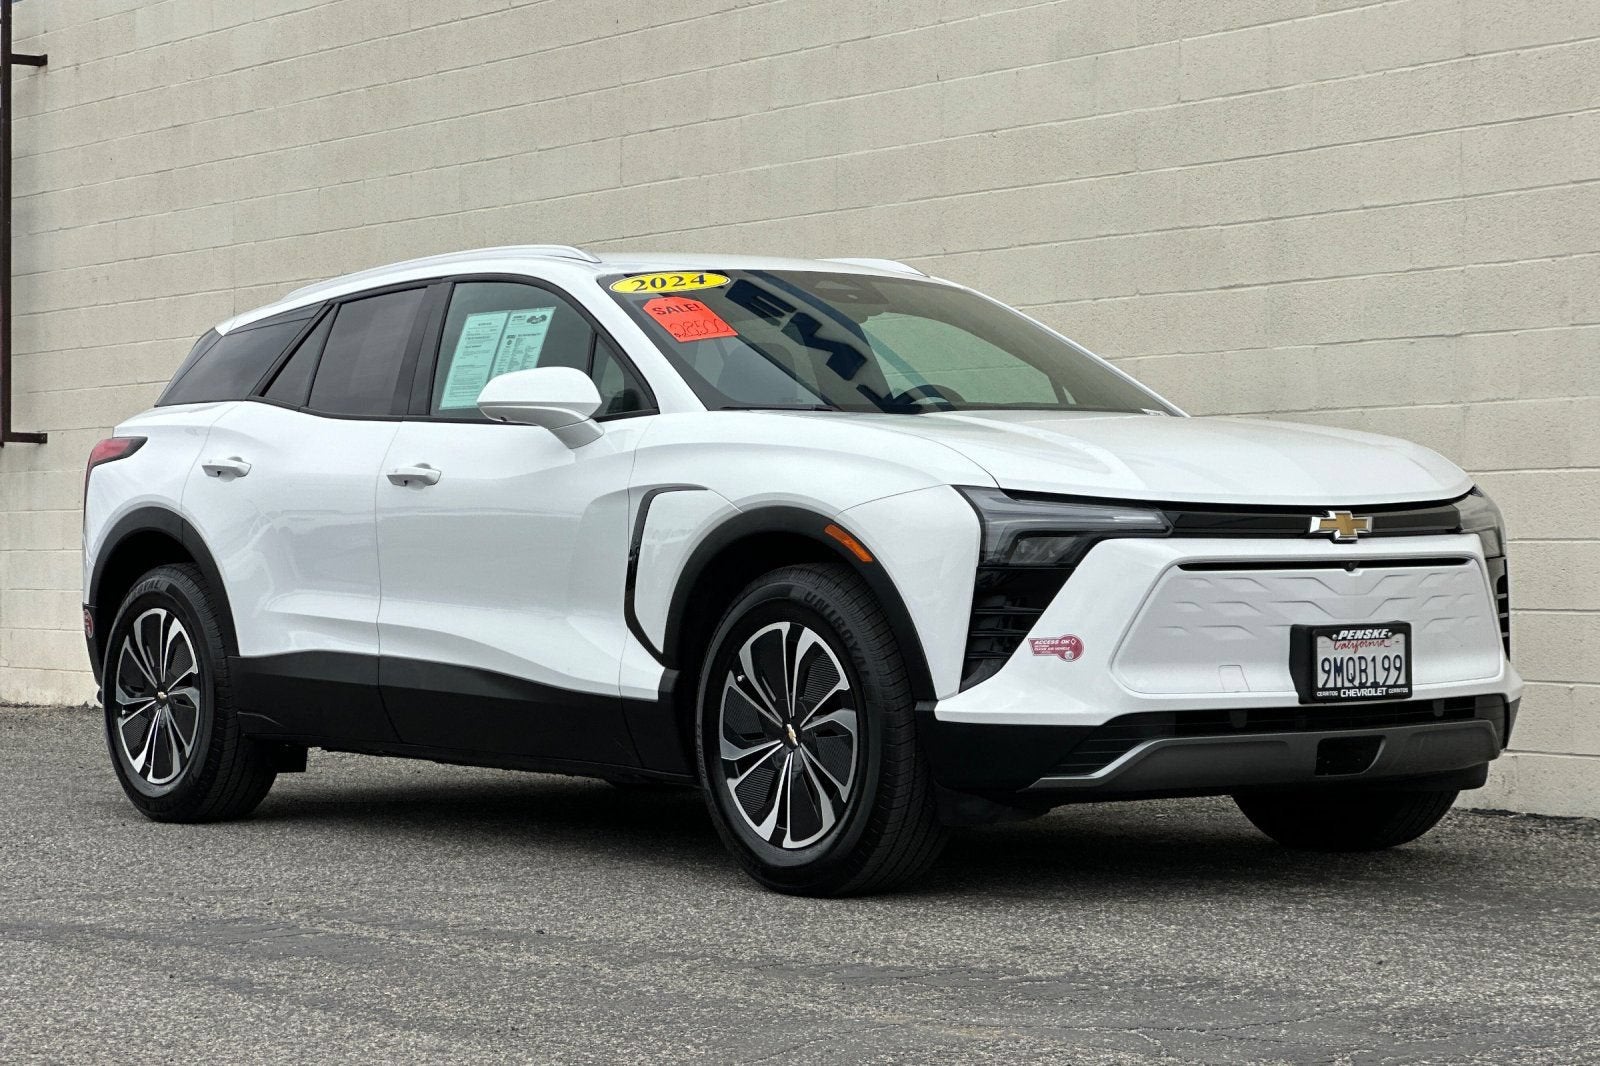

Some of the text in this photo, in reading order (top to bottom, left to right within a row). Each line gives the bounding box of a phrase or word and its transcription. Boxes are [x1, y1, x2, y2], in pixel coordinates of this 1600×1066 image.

[631, 274, 707, 291] 2024
[653, 303, 703, 315] SALE!
[1338, 629, 1390, 639] PENSKE
[1333, 639, 1391, 653] California
[1321, 654, 1402, 687] 9MQB199
[1340, 687, 1387, 698] CHEVROLET
